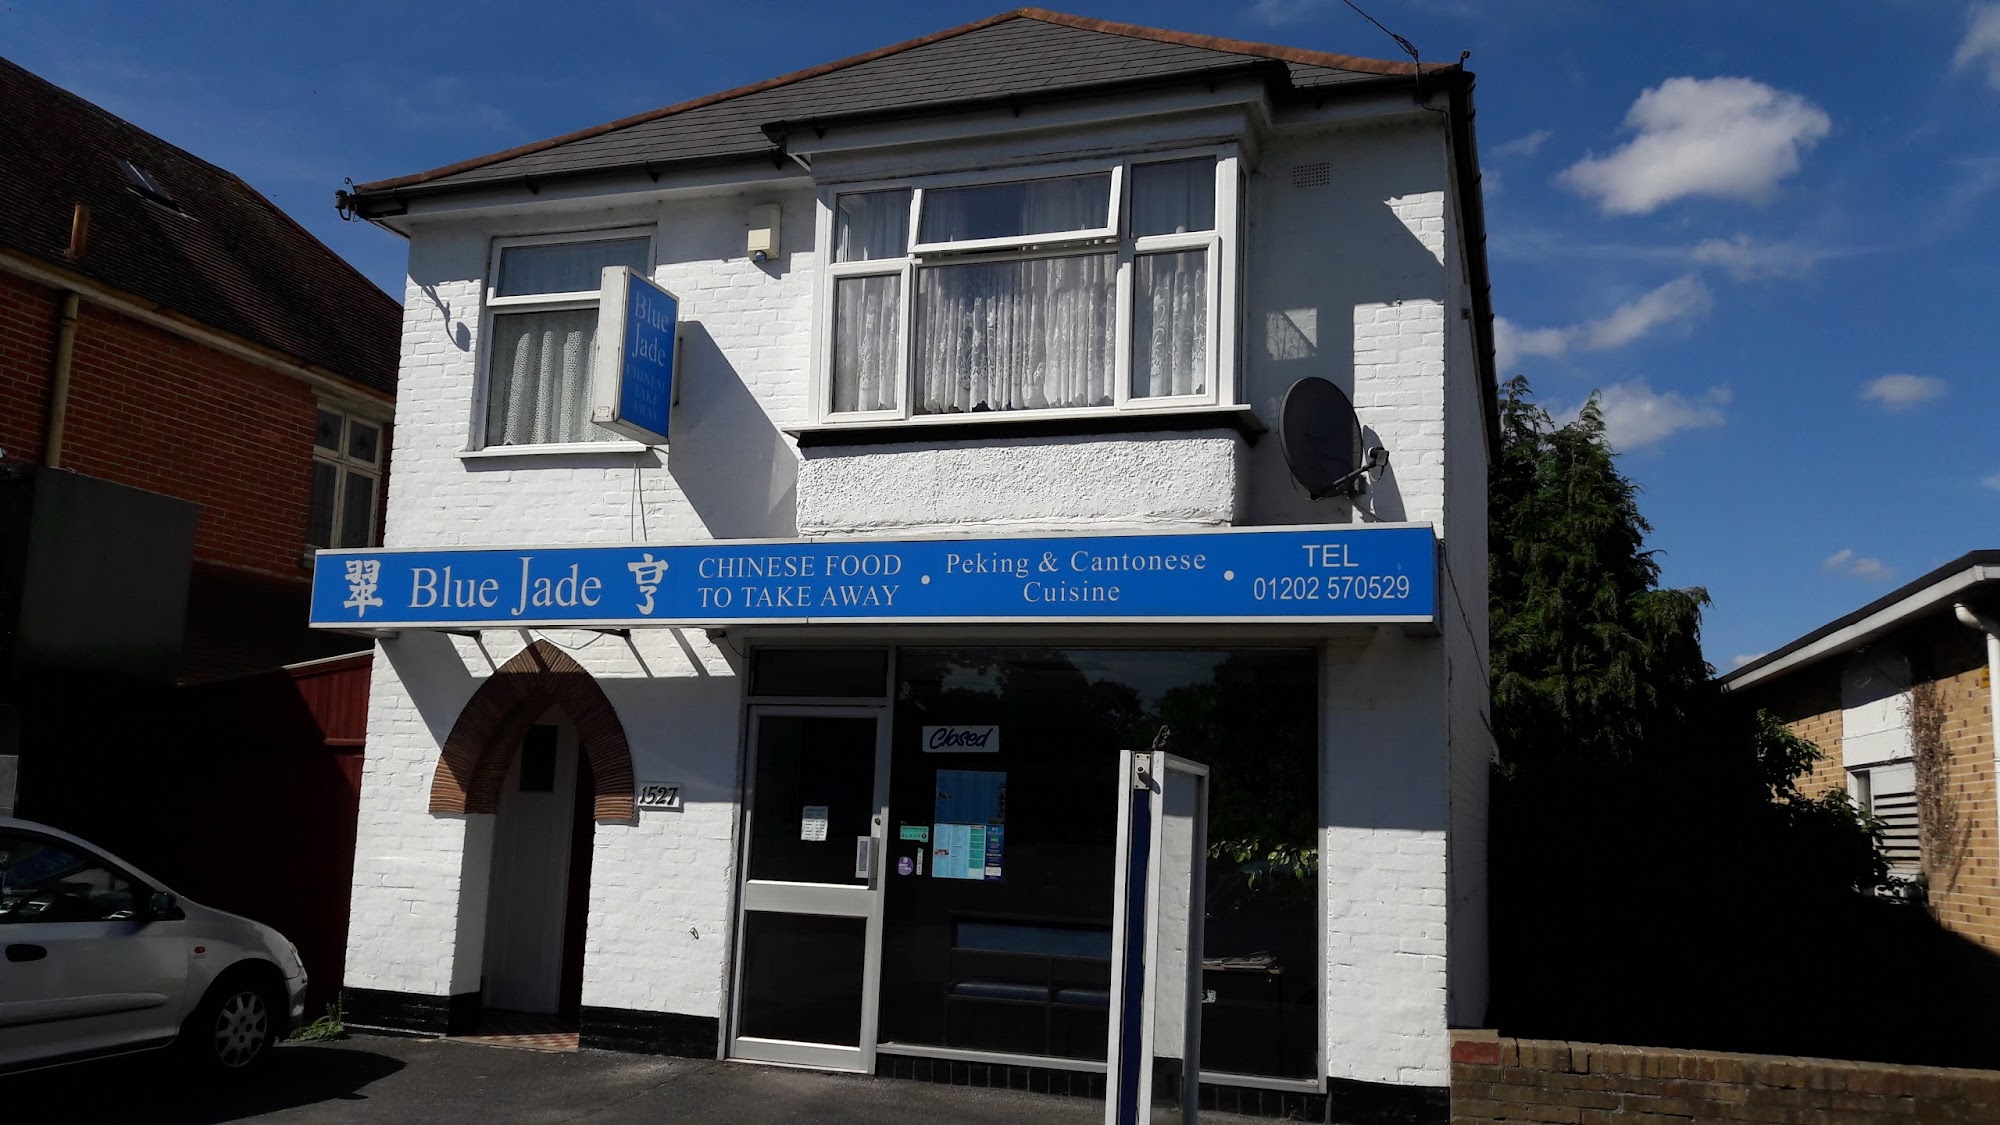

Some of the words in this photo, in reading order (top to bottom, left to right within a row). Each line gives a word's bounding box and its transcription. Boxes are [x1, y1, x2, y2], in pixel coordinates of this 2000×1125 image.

[634, 291, 669, 333] Blue
[631, 323, 666, 367] Jade
[698, 557, 815, 579] CHINESE
[826, 555, 902, 576] FOOD
[946, 552, 1029, 578] Peking
[1038, 552, 1058, 573] &
[1070, 551, 1206, 573] Cantonese
[1302, 544, 1359, 568] TEL
[343, 560, 383, 618] 翠
[408, 566, 499, 608] Blue
[511, 557, 602, 615] Jade
[698, 588, 732, 608] TO
[741, 587, 811, 607] TAKE
[820, 586, 900, 607] AWAY
[1023, 581, 1120, 603] Cuisine
[1253, 576, 1320, 600] 01202
[1327, 575, 1410, 600] 570529
[929, 727, 993, 749] Closed
[639, 785, 679, 806] 1527
